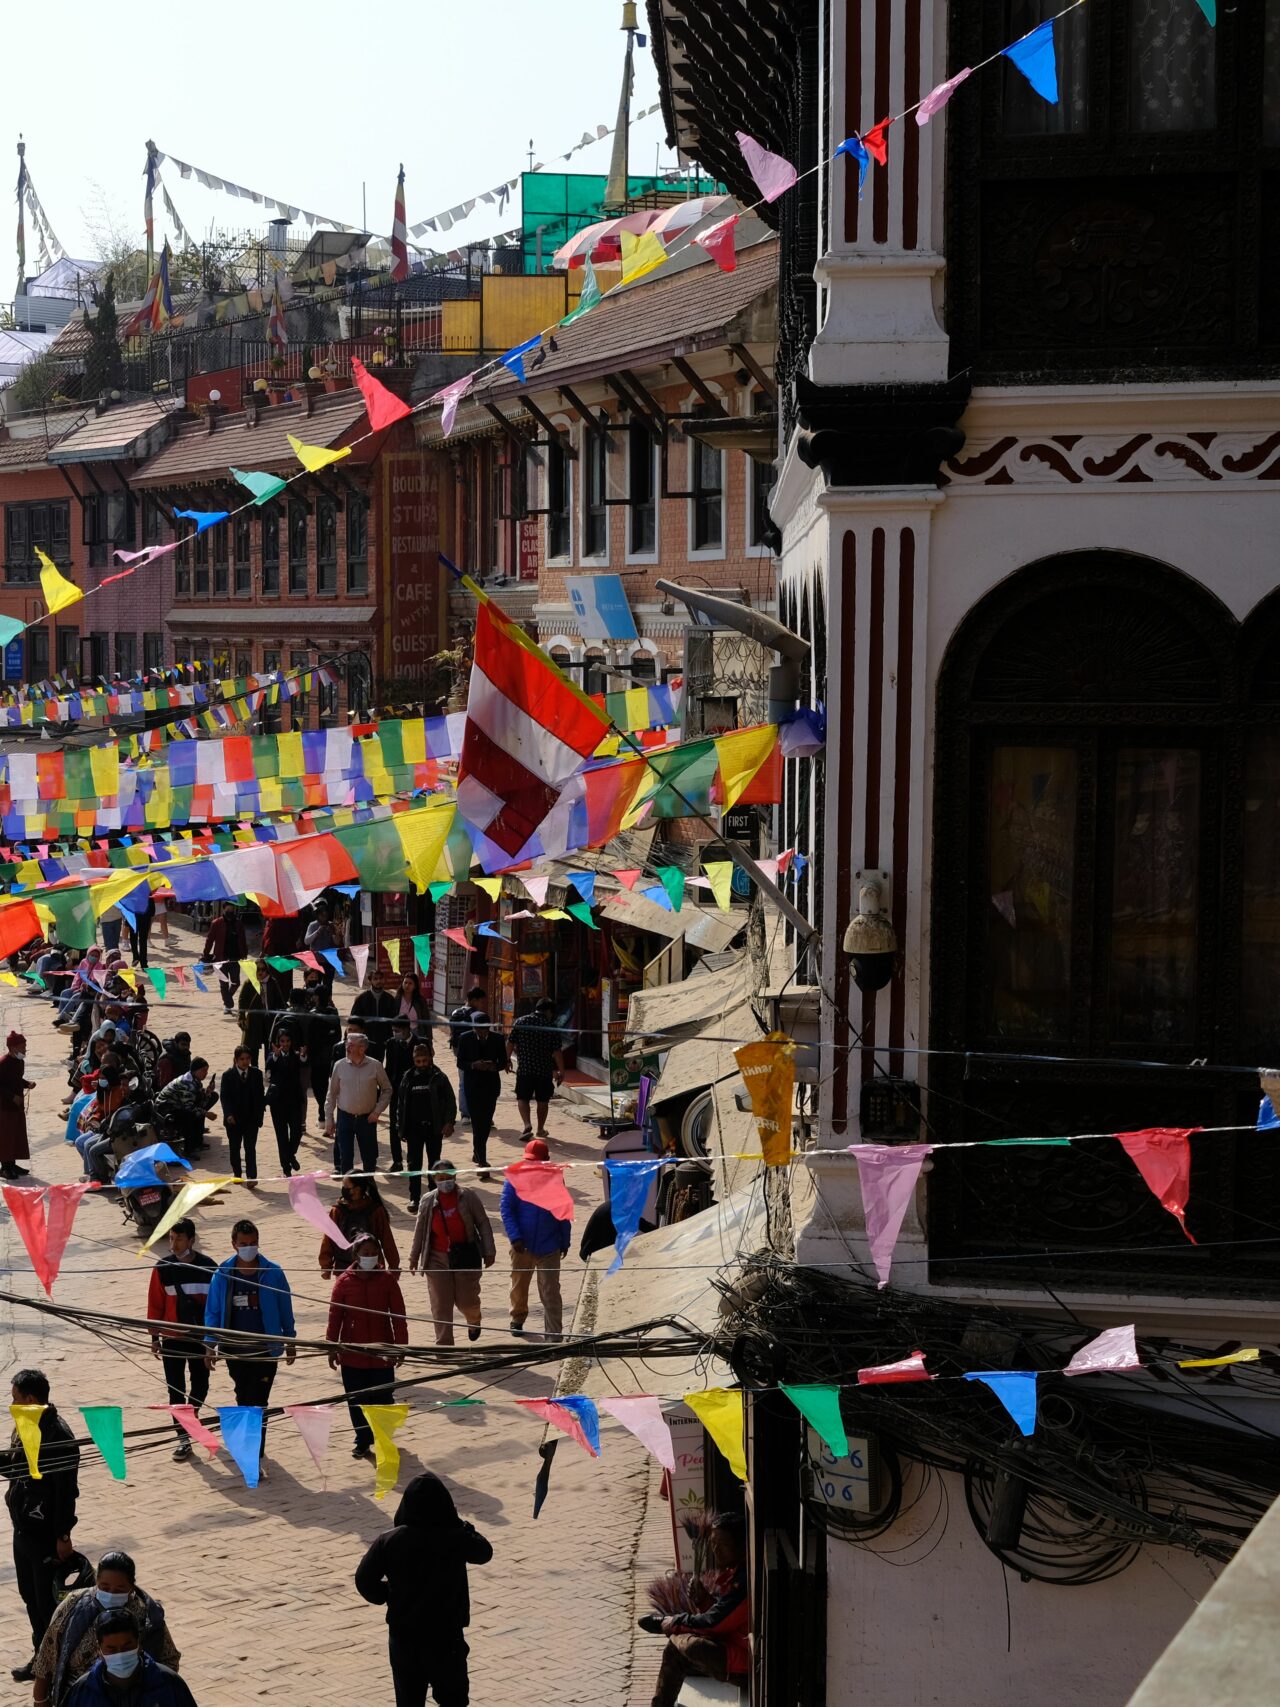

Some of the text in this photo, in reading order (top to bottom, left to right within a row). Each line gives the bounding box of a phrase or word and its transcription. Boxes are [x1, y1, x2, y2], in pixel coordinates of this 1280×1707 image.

[392, 475, 438, 494] BOUDHA
[392, 505, 438, 524] STUPA
[391, 535, 440, 553] RESTAURANT
[396, 583, 433, 601] CAFE
[399, 604, 431, 628] WITH
[392, 634, 438, 653] GUEST
[728, 815, 749, 827] FIRST
